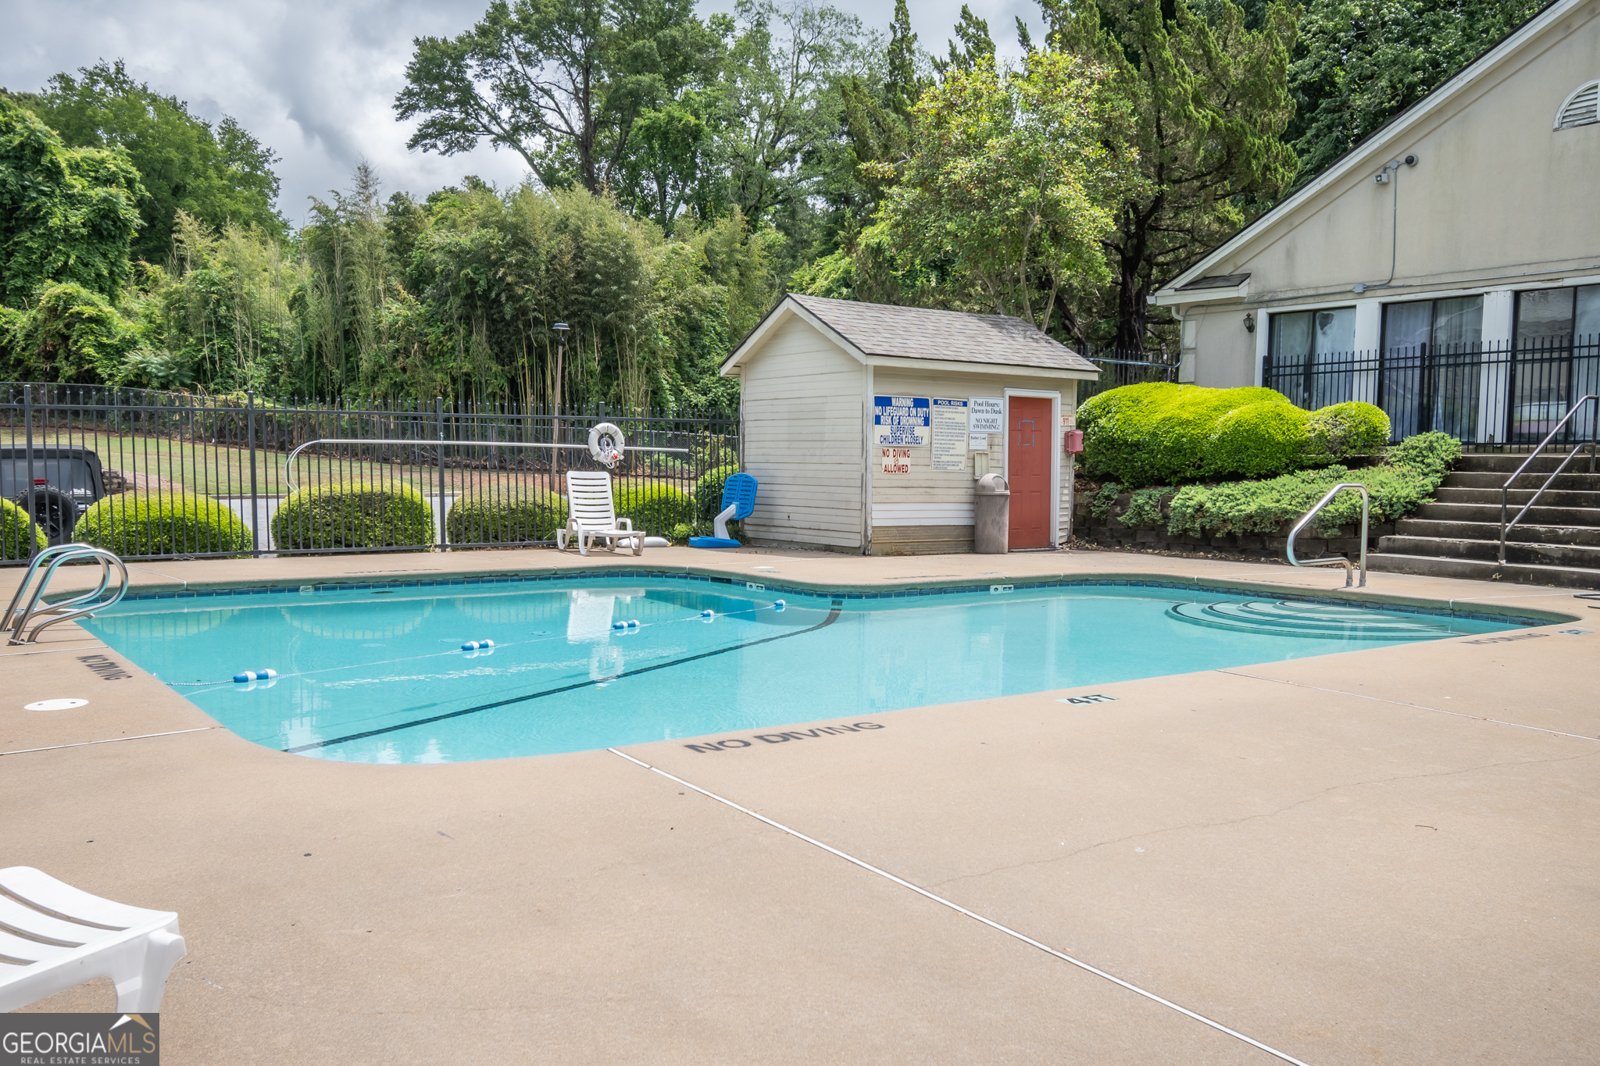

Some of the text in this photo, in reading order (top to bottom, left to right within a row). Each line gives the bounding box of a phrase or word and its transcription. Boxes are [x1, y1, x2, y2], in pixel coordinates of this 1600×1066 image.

[892, 397, 914, 407] WARNING
[875, 406, 929, 418] NO LIFEGUARD ON DUTY
[881, 415, 925, 426] RISK OF DROWNING
[890, 426, 915, 436] SUPERVISE
[880, 435, 924, 445] CHILDREN CLOSELY
[882, 449, 911, 459] NO DIVING
[884, 464, 909, 473] ALLOWED
[684, 721, 886, 754] NO DIVING
